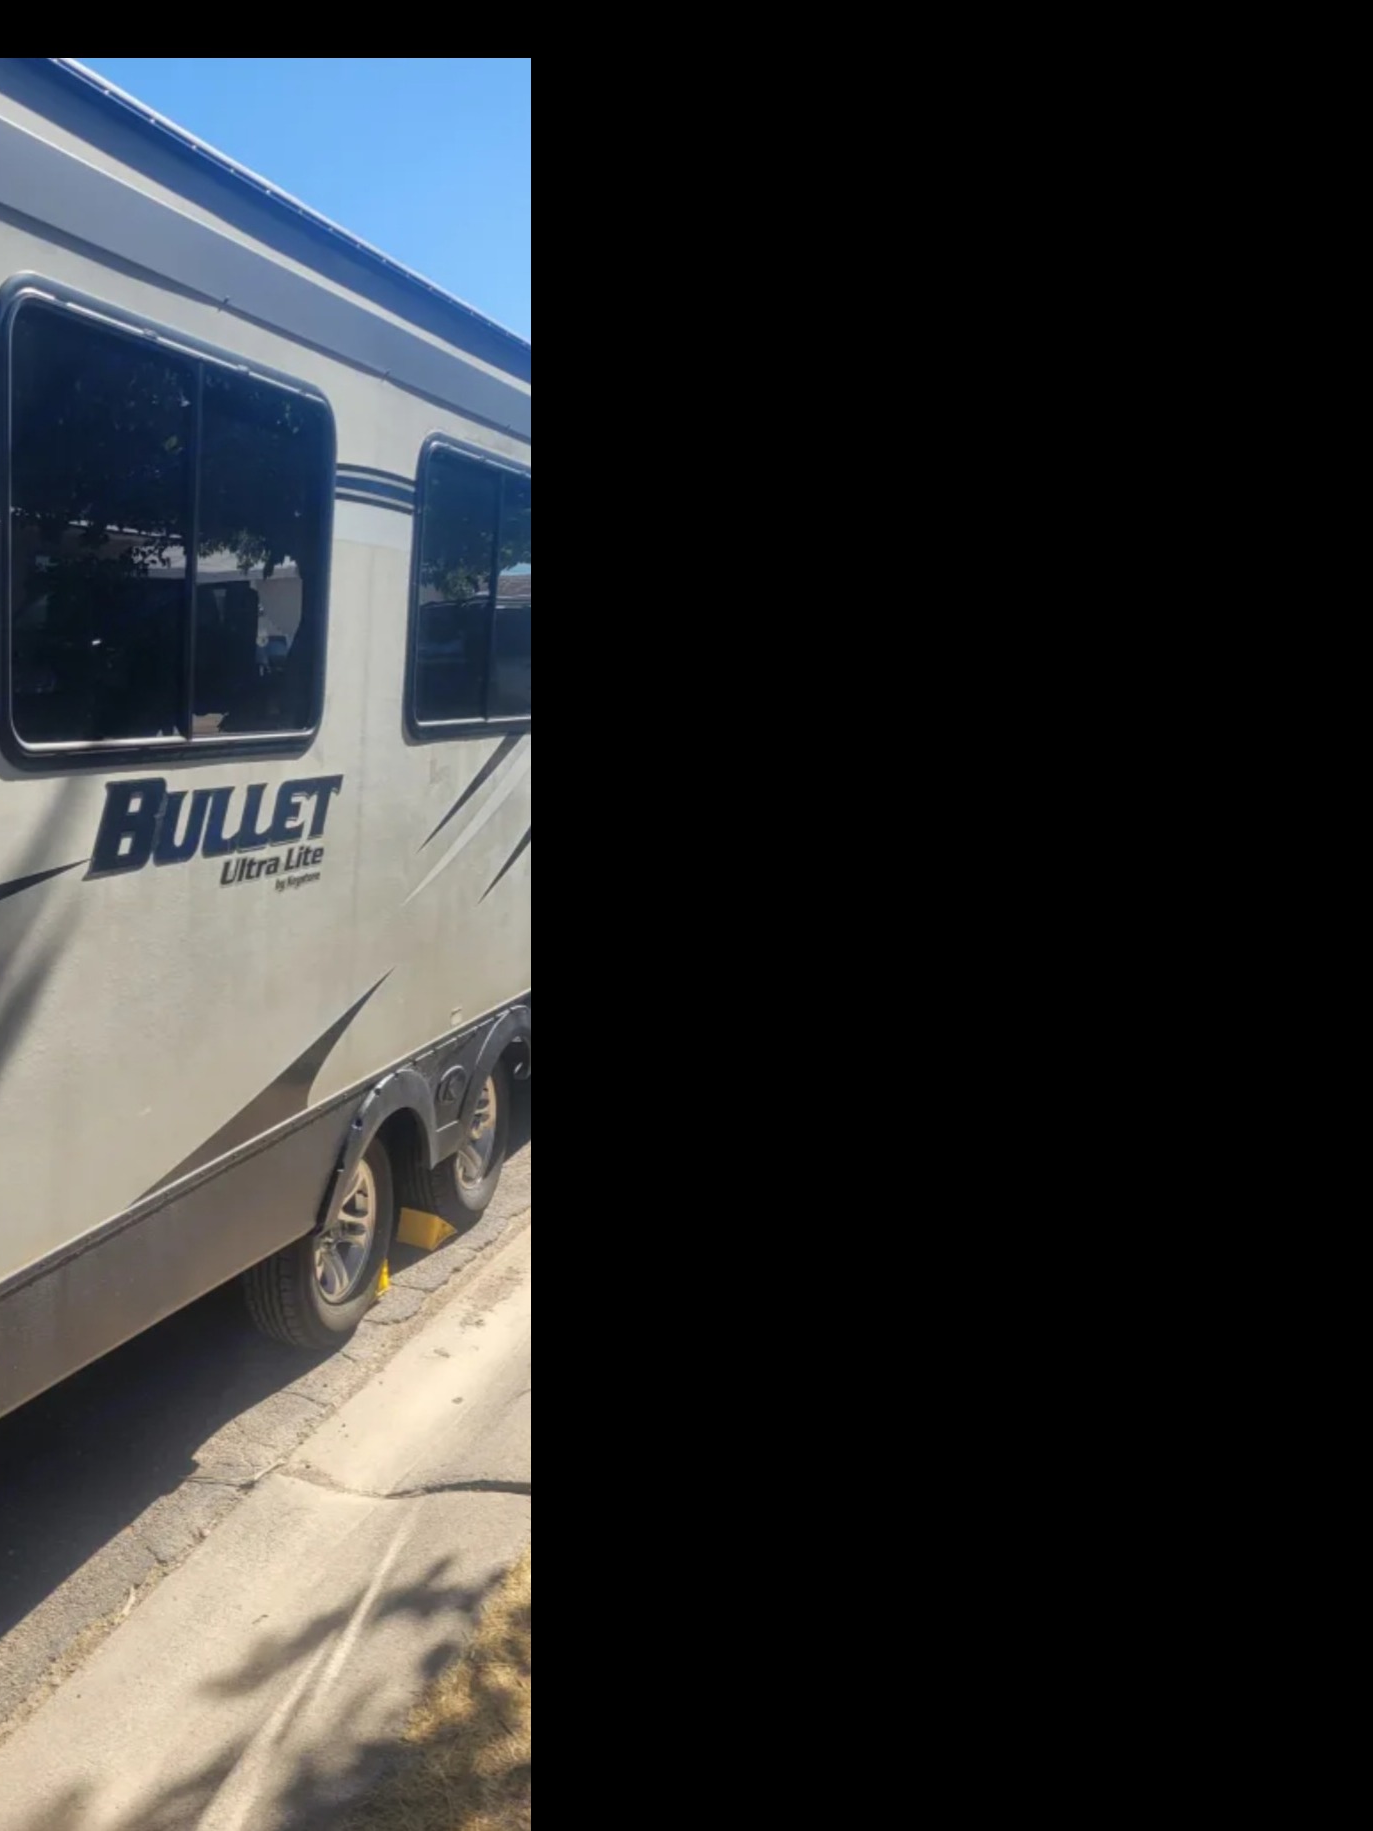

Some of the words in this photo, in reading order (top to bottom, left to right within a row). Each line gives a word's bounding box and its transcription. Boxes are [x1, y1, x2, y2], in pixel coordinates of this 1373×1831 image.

[83, 774, 344, 882] BULLET
[220, 856, 280, 886] Ultra
[284, 845, 324, 872] Lite
[275, 878, 286, 892] by
